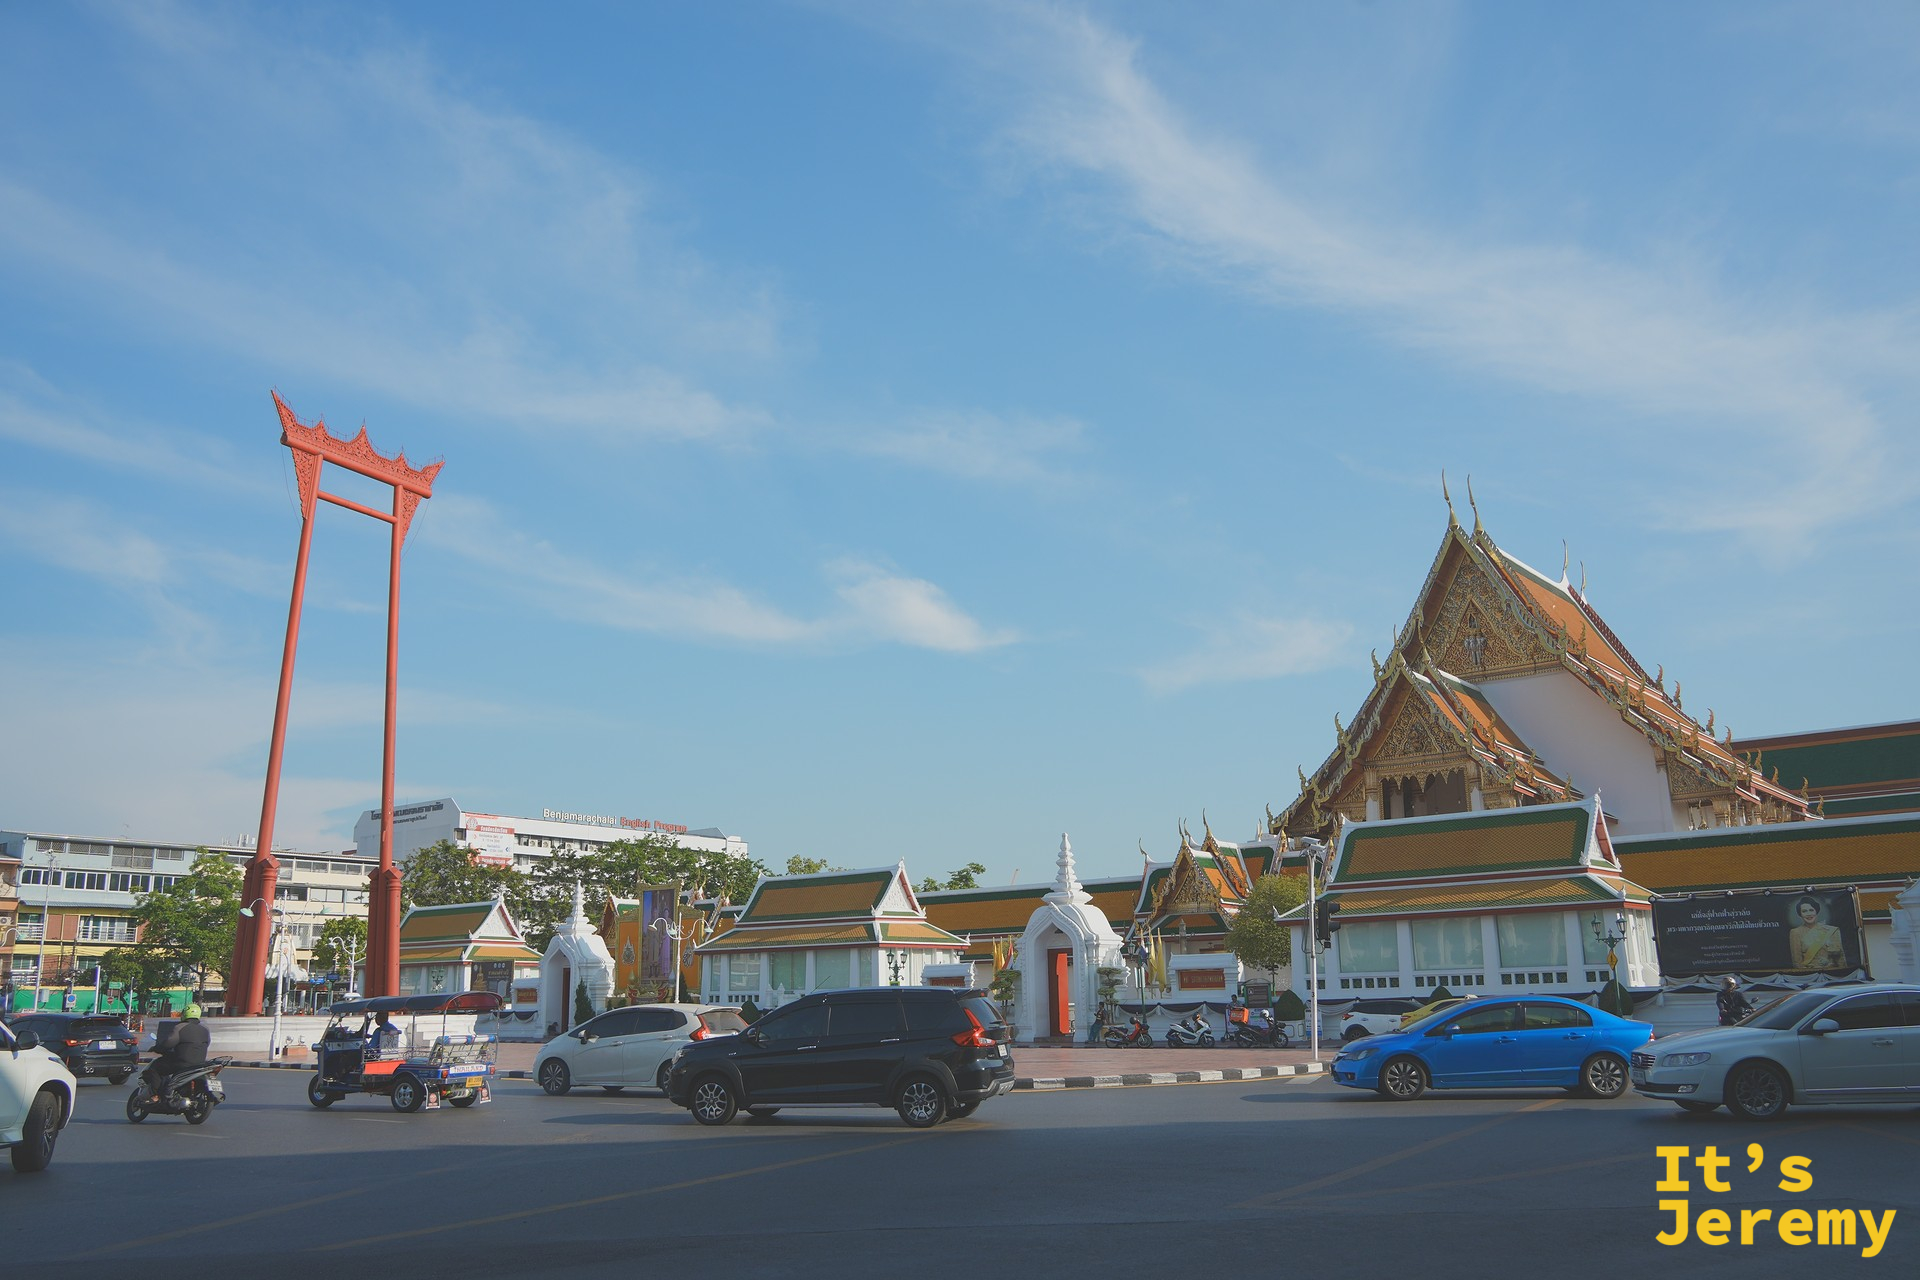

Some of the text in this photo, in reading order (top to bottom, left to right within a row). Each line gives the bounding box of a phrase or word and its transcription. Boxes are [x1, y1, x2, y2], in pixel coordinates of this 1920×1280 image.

[543, 808, 687, 832] Benjamarachalai English Program
